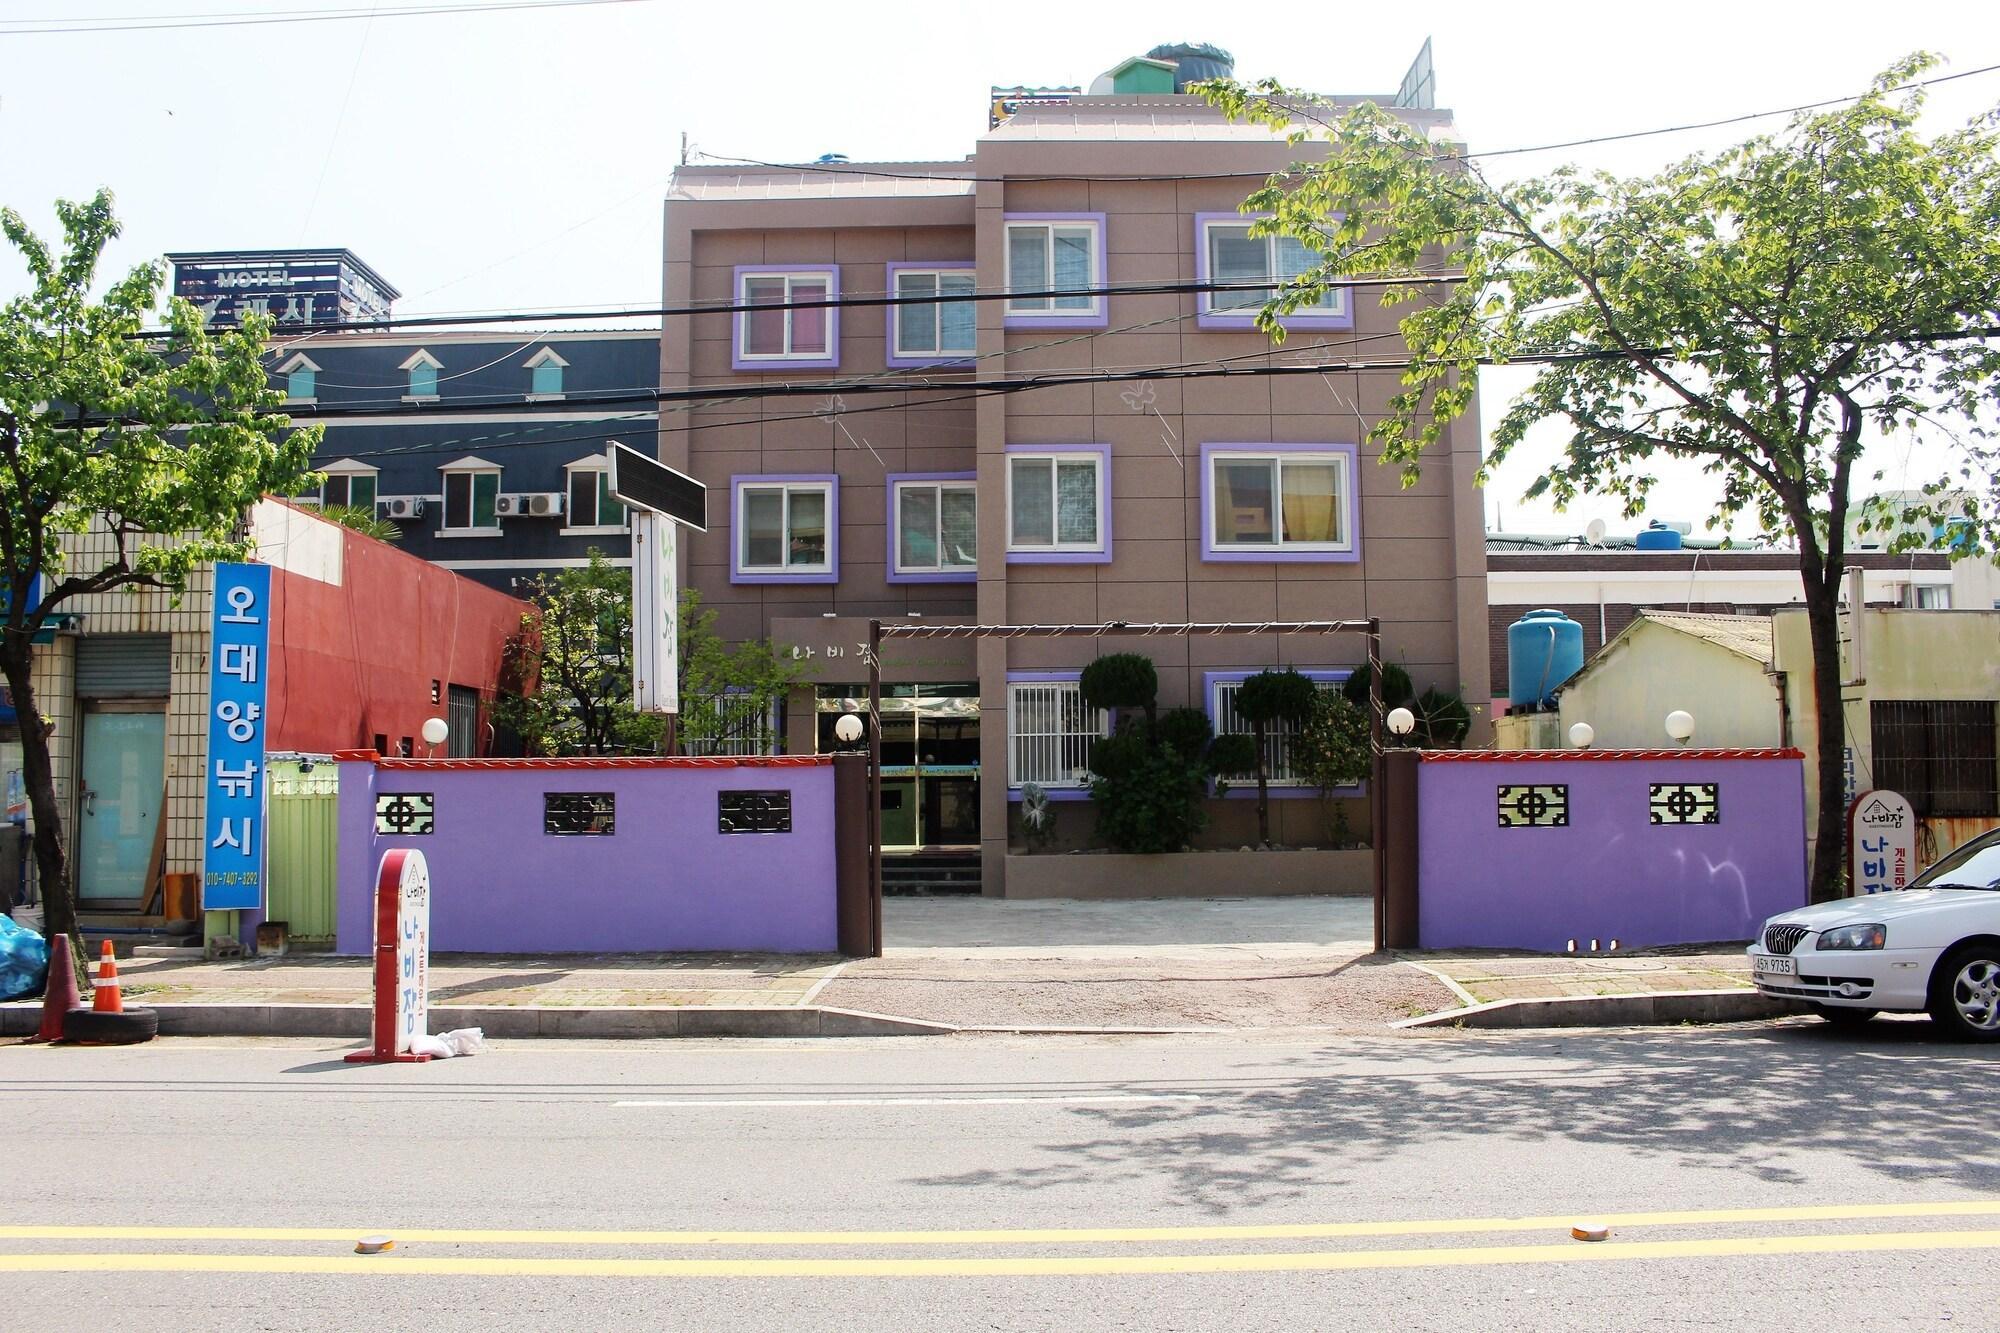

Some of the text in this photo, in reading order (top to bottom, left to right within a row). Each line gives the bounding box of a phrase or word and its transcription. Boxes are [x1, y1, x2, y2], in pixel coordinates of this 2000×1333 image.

[218, 270, 295, 288] MOTEL
[661, 527, 674, 657] 나비잠
[1862, 812, 1904, 829] 나비잠
[1770, 959, 1791, 973] 9735
[404, 916, 419, 1035] 나비잠
